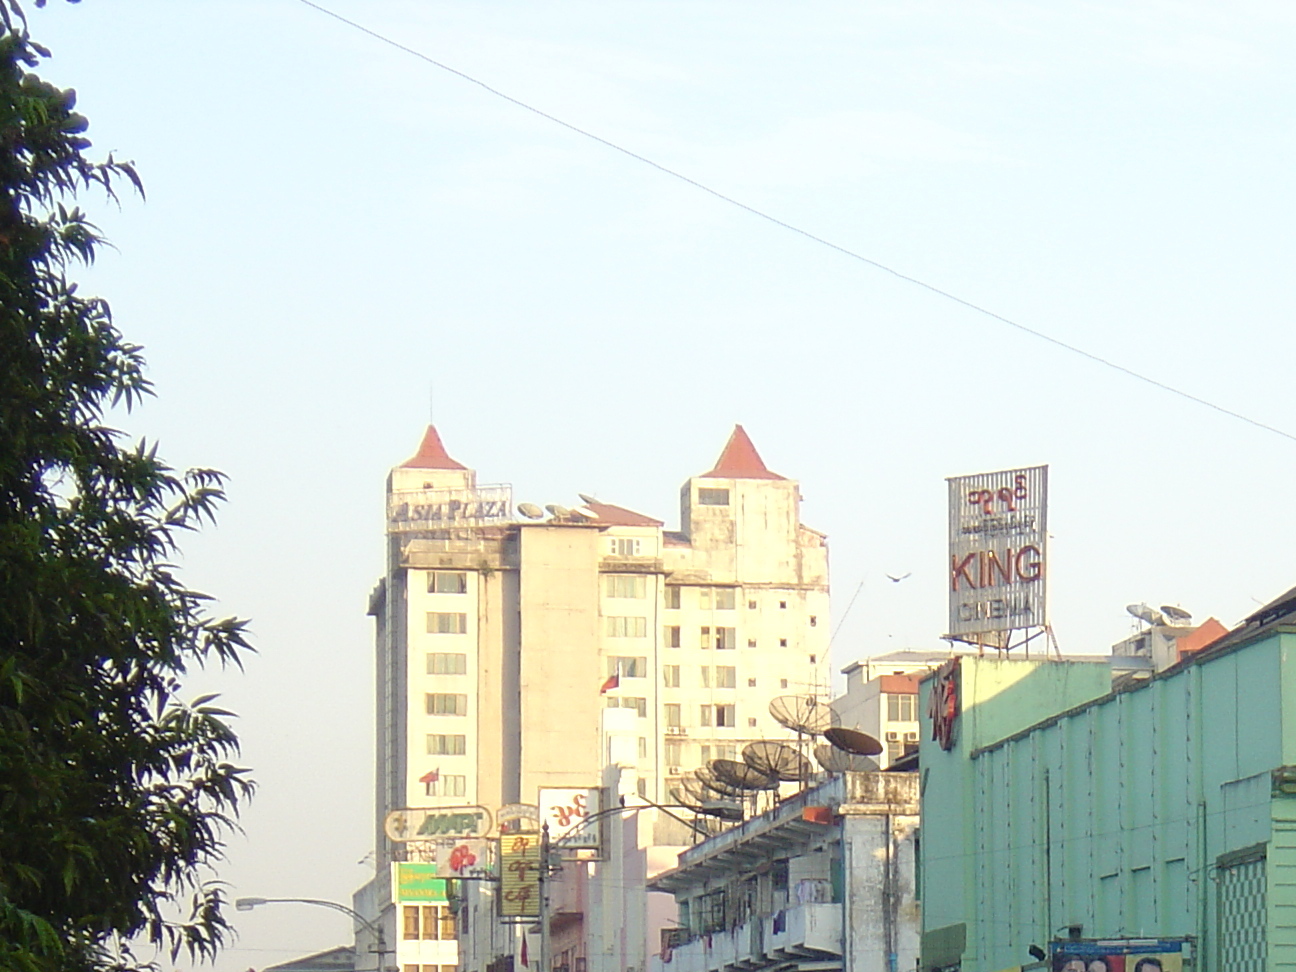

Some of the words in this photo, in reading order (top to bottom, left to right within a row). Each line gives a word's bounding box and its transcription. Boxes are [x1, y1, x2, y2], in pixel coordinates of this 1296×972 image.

[391, 502, 442, 523] ASIA
[449, 499, 506, 520] PLAZA
[952, 545, 1042, 592] KING
[958, 597, 1035, 622] CINEMA
